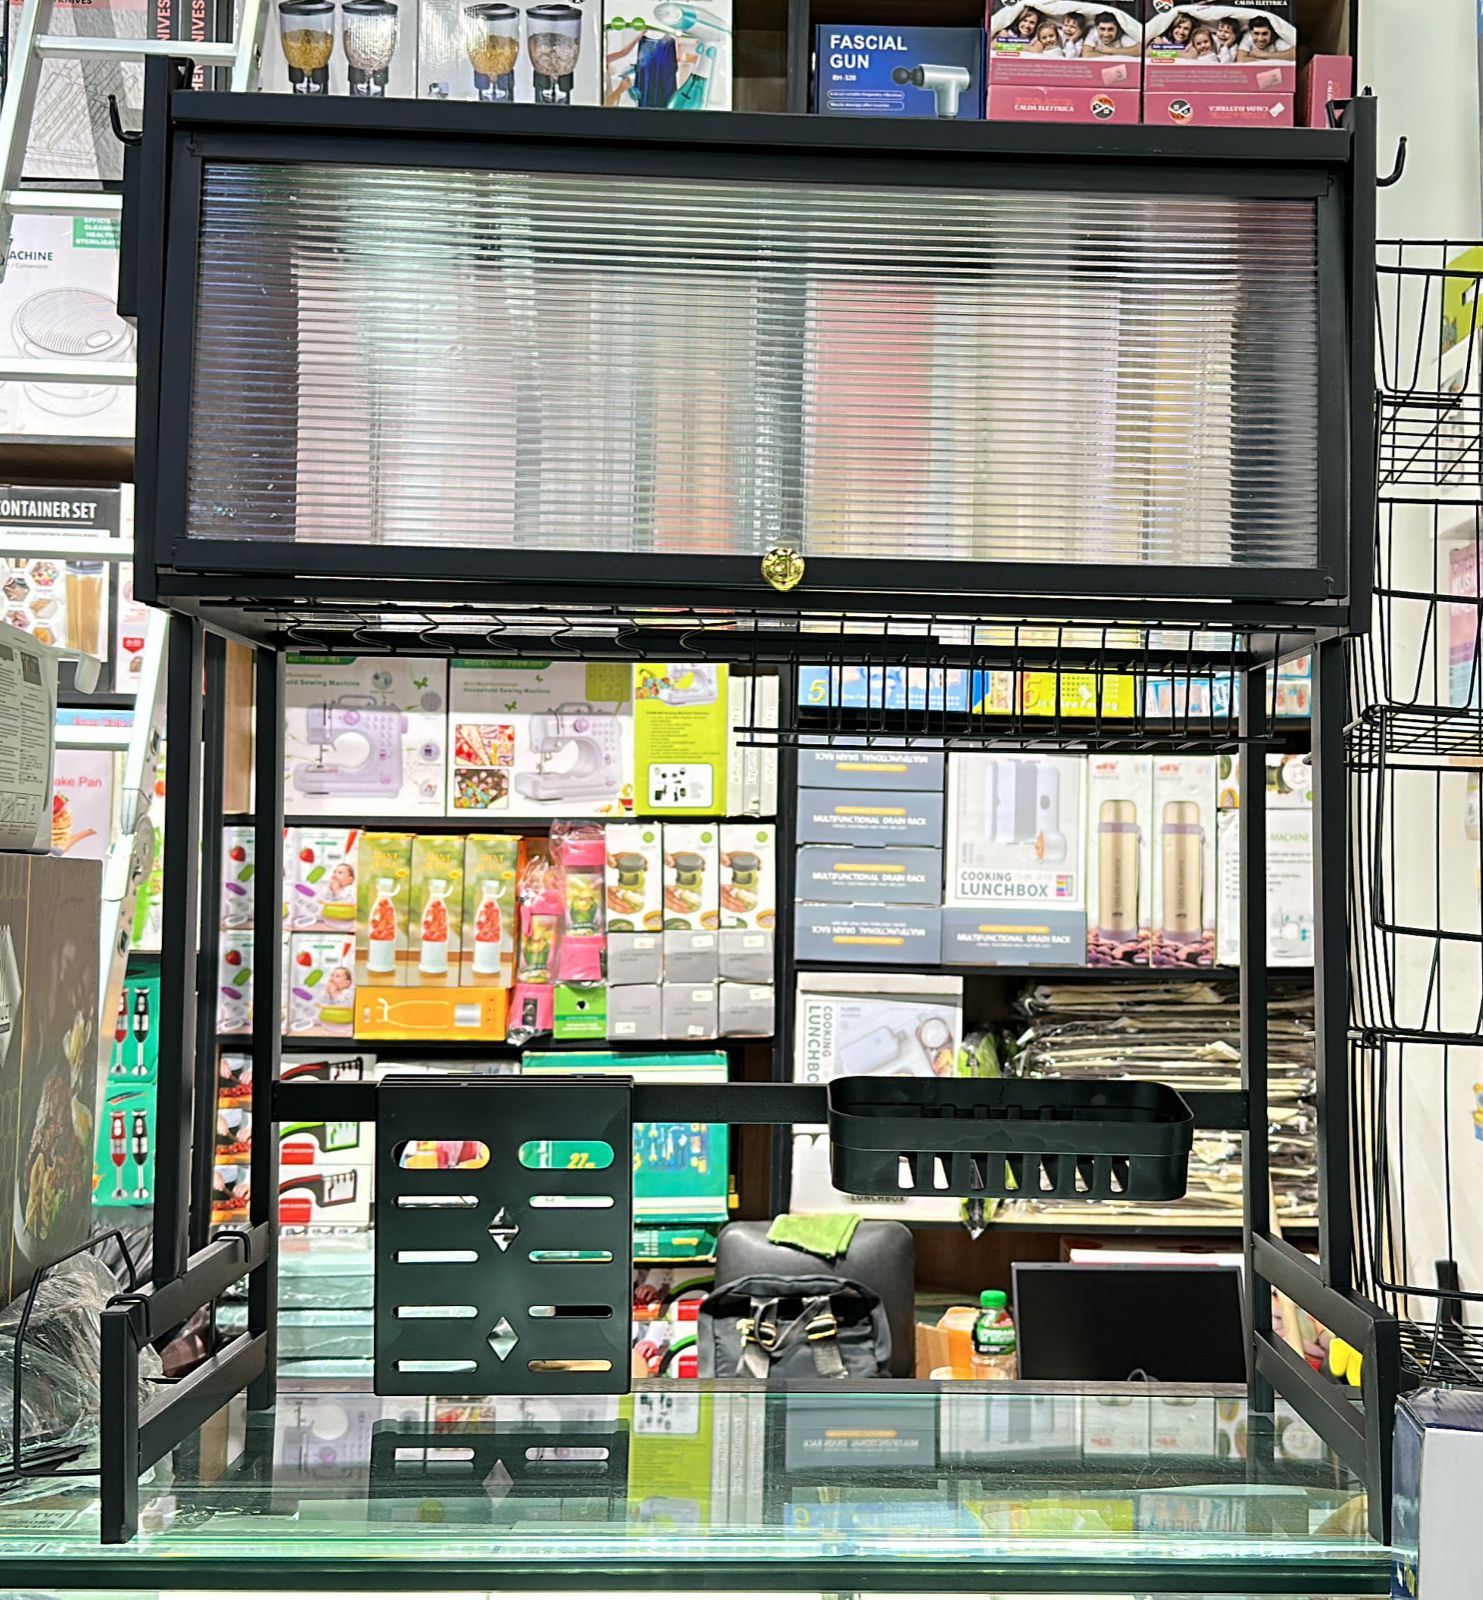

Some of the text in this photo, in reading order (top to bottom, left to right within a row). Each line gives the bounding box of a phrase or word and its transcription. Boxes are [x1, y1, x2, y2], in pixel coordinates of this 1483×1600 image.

[157, 0, 171, 41] NIVES
[192, 1, 205, 42] NIVES
[830, 34, 908, 51] FASCIAL
[830, 54, 869, 69] GUN
[1038, 104, 1074, 112] ELETTRICA
[9, 251, 54, 261] ACHINE
[0, 500, 98, 519] ONTAINER SET
[807, 679, 827, 704] 5
[815, 752, 929, 763] MULTIFUNCTIONAL DRAIN RACK
[54, 776, 102, 788] ake Pan
[812, 815, 926, 826] MULTIFUNCTIONAL DRAIN RACK
[812, 872, 925, 883] MULTIFUNCTIONAL DRAIN RACK
[961, 871, 1012, 882] COOKING
[960, 882, 1048, 897] LUNCHBOX
[812, 925, 926, 936] MULTIFUNCTIONAL DRAIN RACK
[957, 933, 1071, 944] MULTIFUNCTIONAL DRAIN RACK
[822, 1005, 833, 1058] COOKING
[807, 1005, 821, 1083] LUNCHBO
